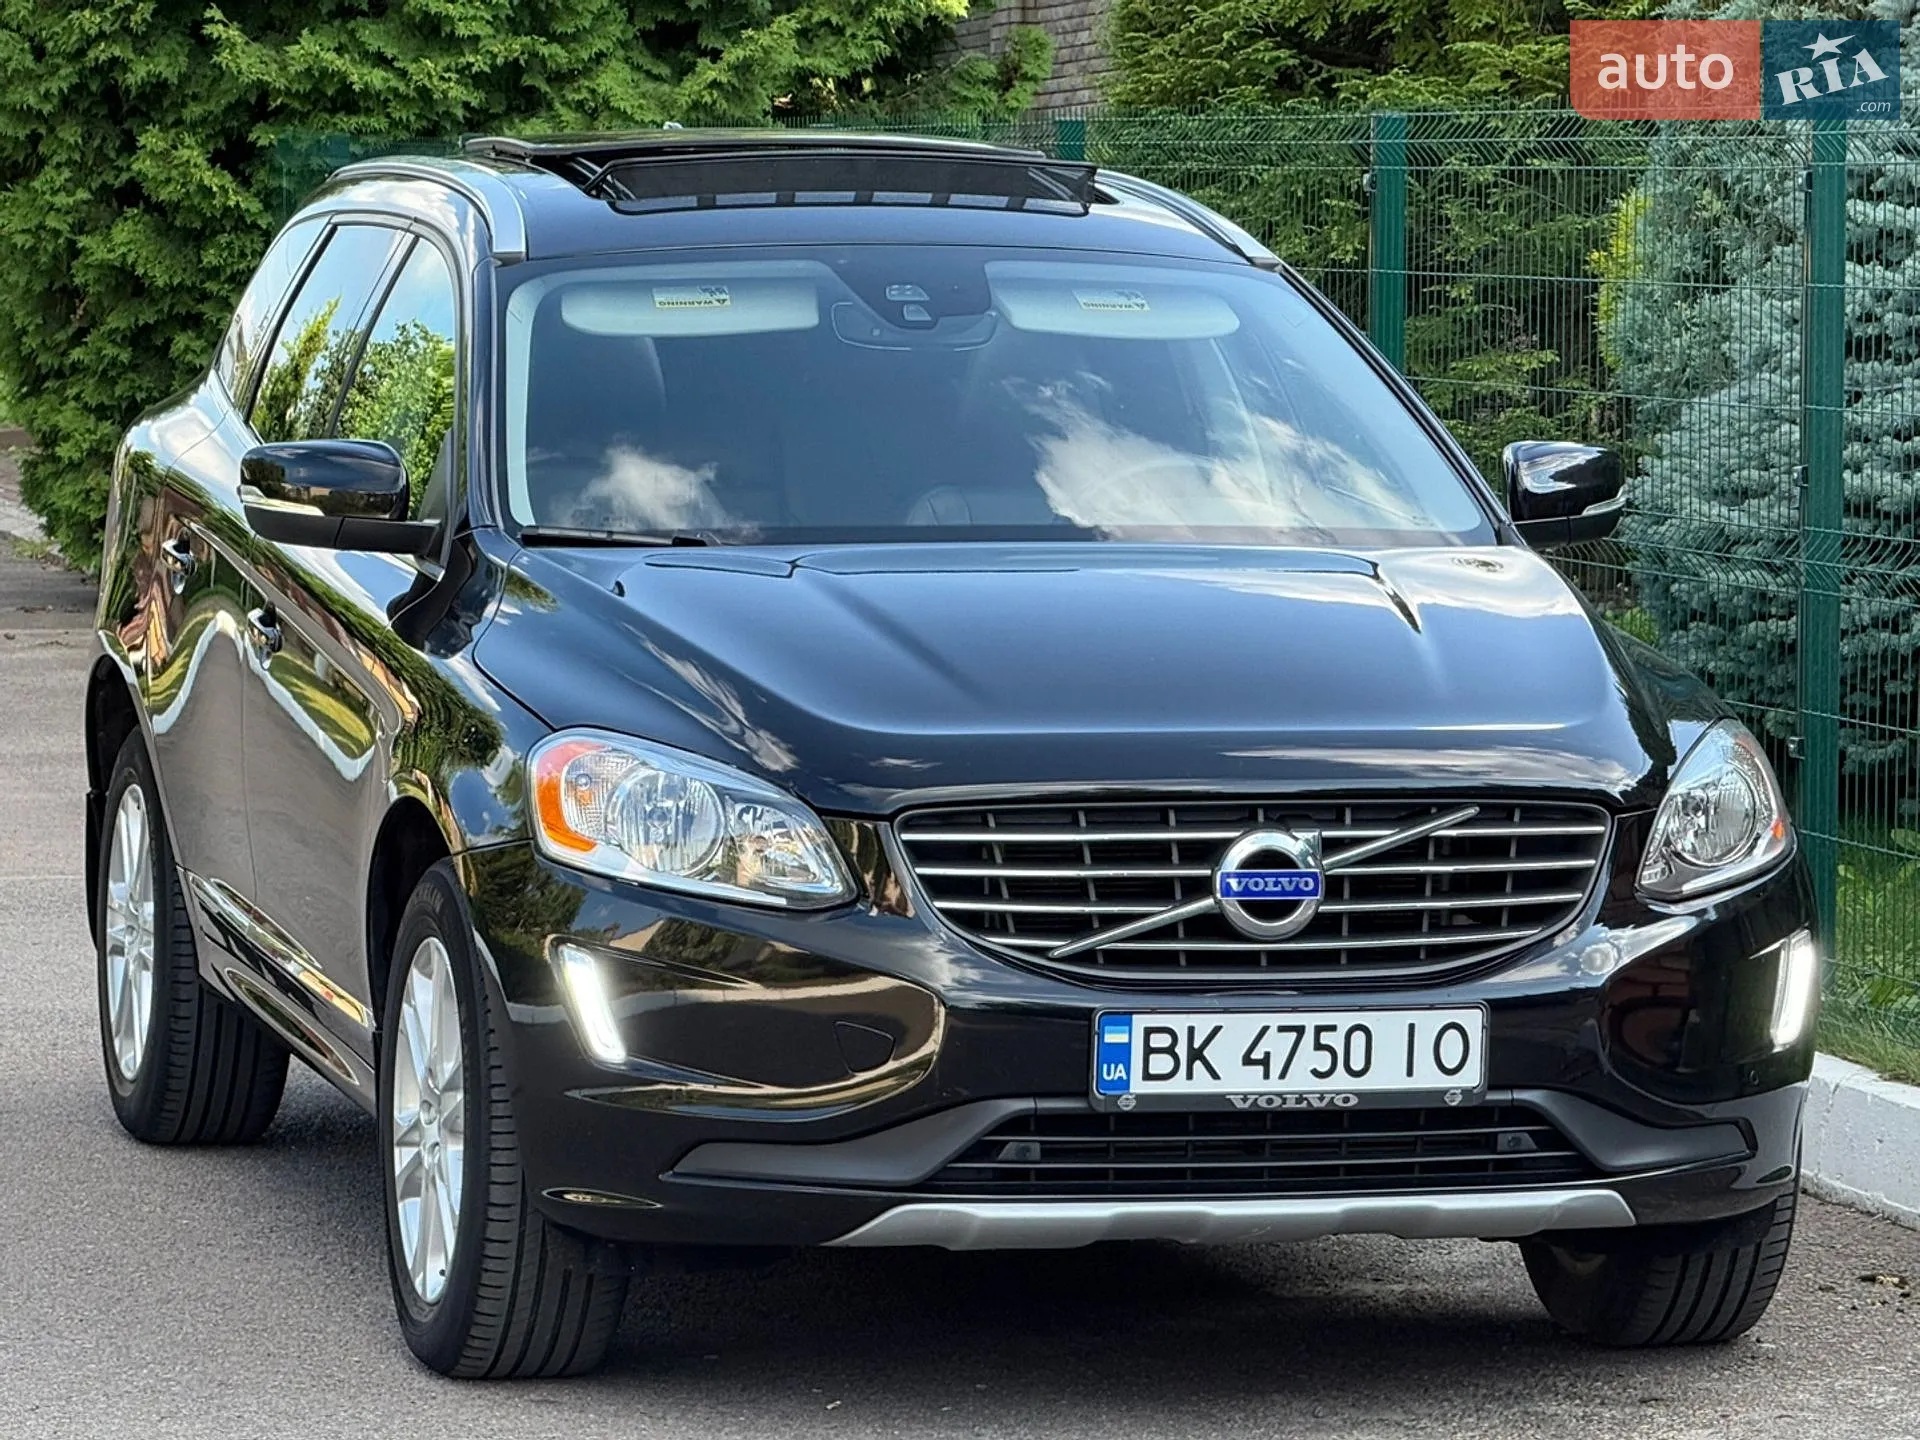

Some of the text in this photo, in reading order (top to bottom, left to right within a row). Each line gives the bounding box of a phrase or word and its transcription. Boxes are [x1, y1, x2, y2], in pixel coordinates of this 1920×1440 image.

[1226, 877, 1315, 892] VOLVO
[1141, 1024, 1223, 1082] BK
[1241, 1023, 1373, 1081] 4750
[1102, 1063, 1127, 1081] UA
[1225, 1093, 1359, 1109] VOLVO
